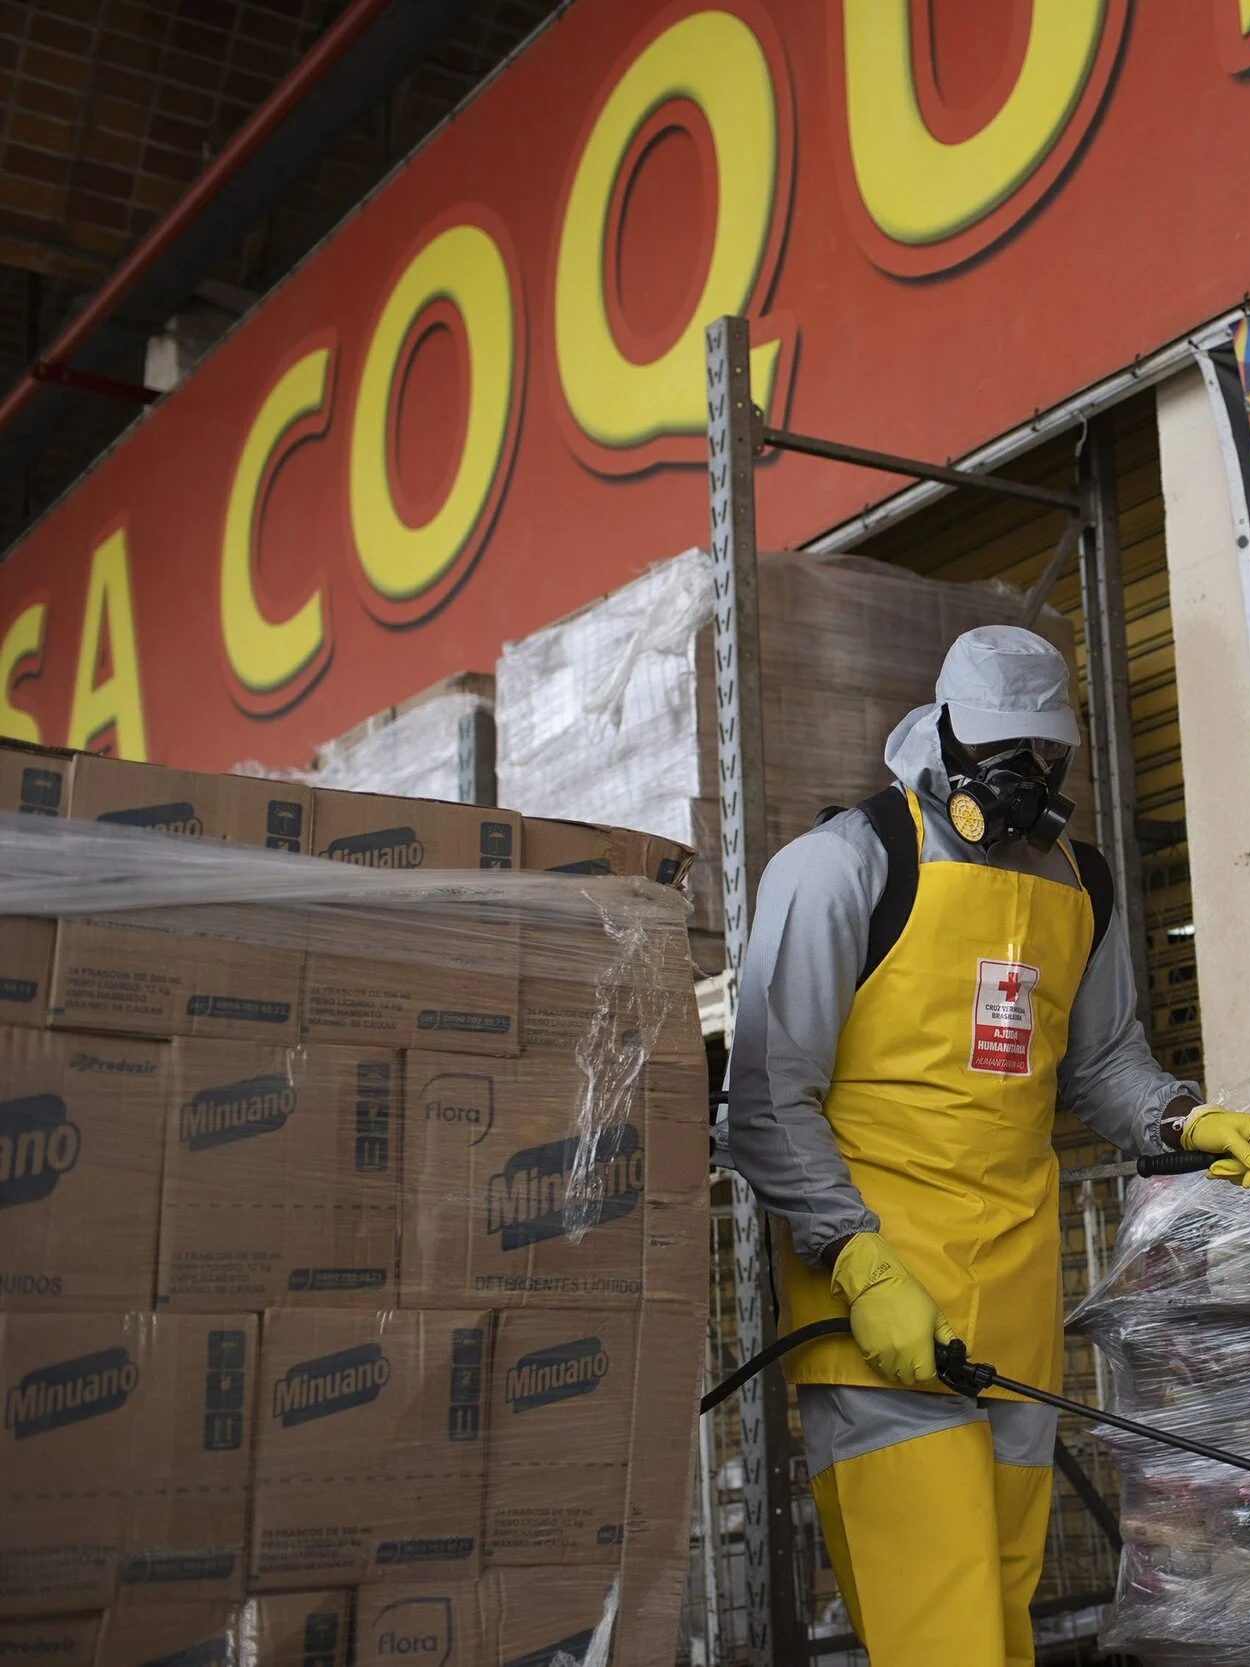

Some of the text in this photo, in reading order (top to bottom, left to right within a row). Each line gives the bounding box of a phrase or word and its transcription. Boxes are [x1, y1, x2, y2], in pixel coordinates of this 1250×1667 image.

[181, 1086, 297, 1143] Minuano
[425, 1102, 480, 1124] flora
[0, 1274, 62, 1296] UIDOS
[5, 1361, 139, 1429] Minuano
[272, 1356, 391, 1419] Minuano
[506, 1350, 609, 1403] Minuano
[378, 1632, 438, 1654] flora
